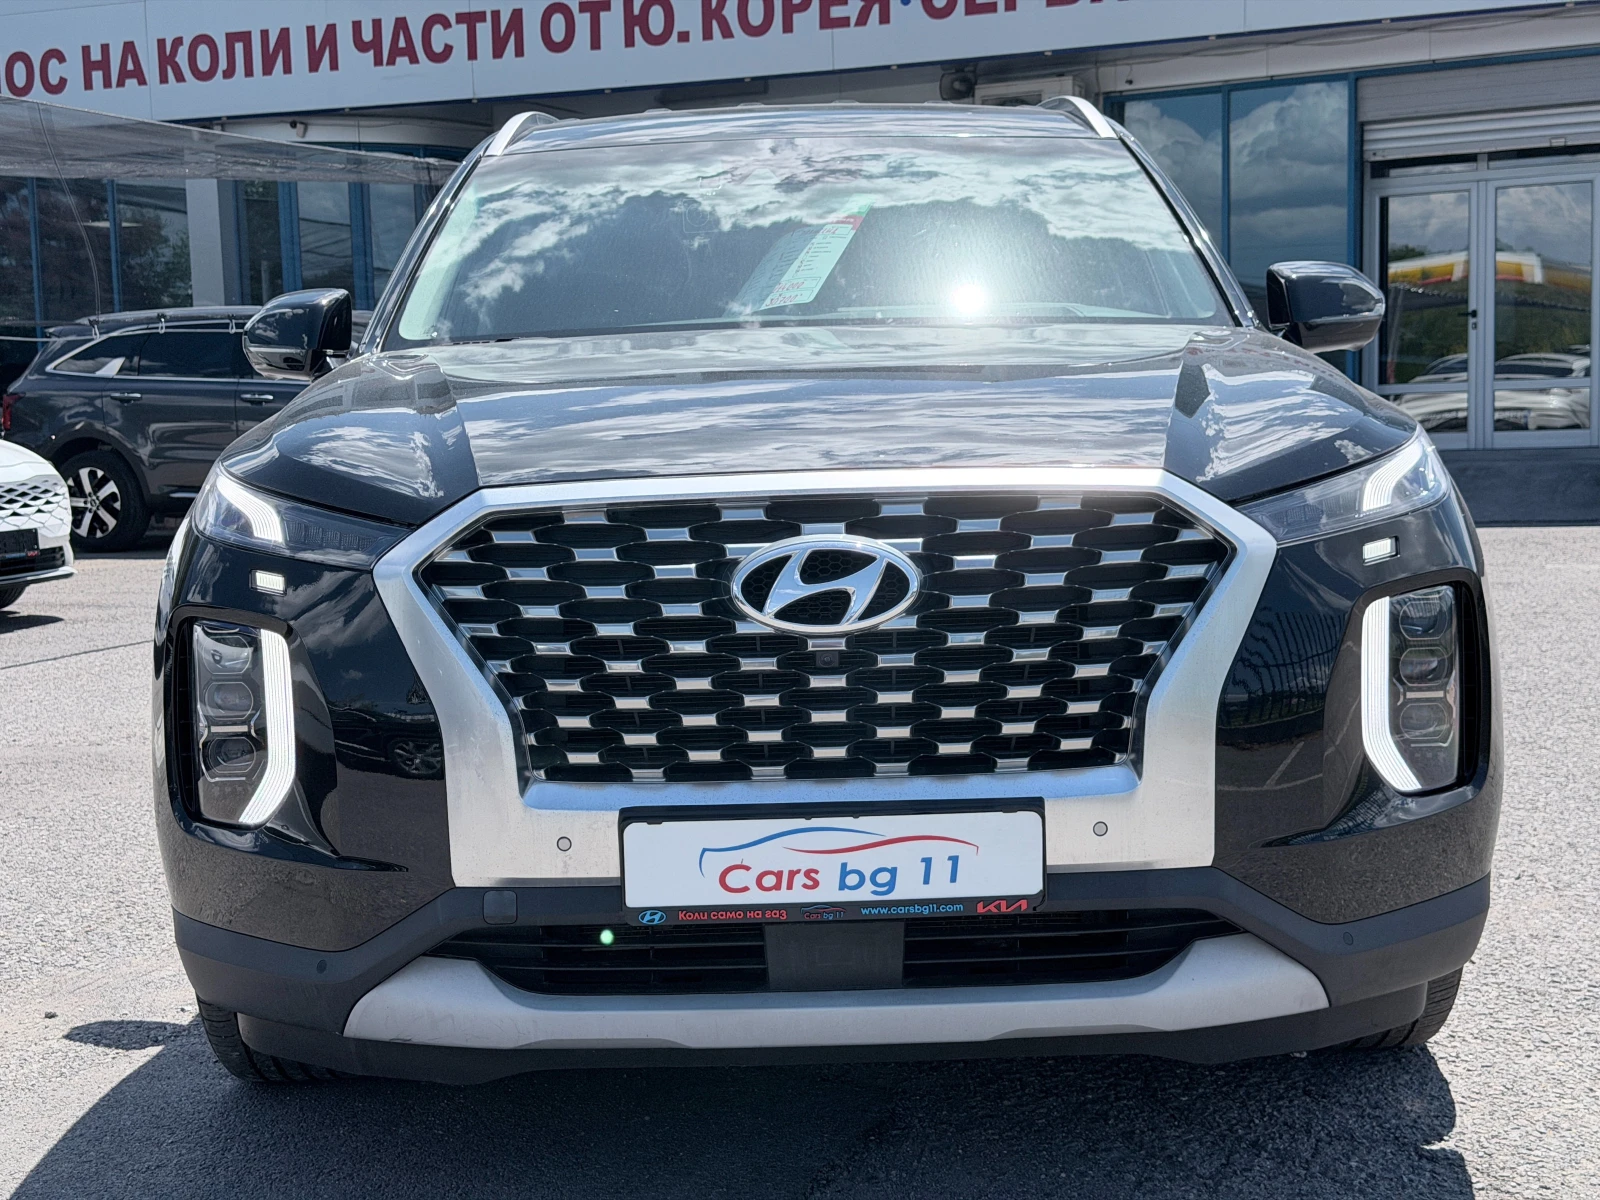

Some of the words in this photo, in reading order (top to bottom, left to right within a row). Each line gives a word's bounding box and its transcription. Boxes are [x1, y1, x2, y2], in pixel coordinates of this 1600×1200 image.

[0, 48, 68, 97] ОС
[81, 40, 148, 91] НА
[156, 27, 291, 85] КОЛИ
[306, 23, 339, 73] И
[352, 8, 525, 67] ЧАСТИ
[540, 0, 612, 53] ОТ
[718, 862, 821, 894] Cars
[838, 861, 898, 897] bg
[920, 855, 960, 886] 11
[678, 910, 708, 921] Коли
[711, 911, 744, 921] само
[747, 910, 762, 919] на
[765, 909, 787, 920] газ
[804, 911, 822, 920] Cars
[823, 911, 834, 920] bg
[860, 903, 964, 916] www.carsbg11.com
